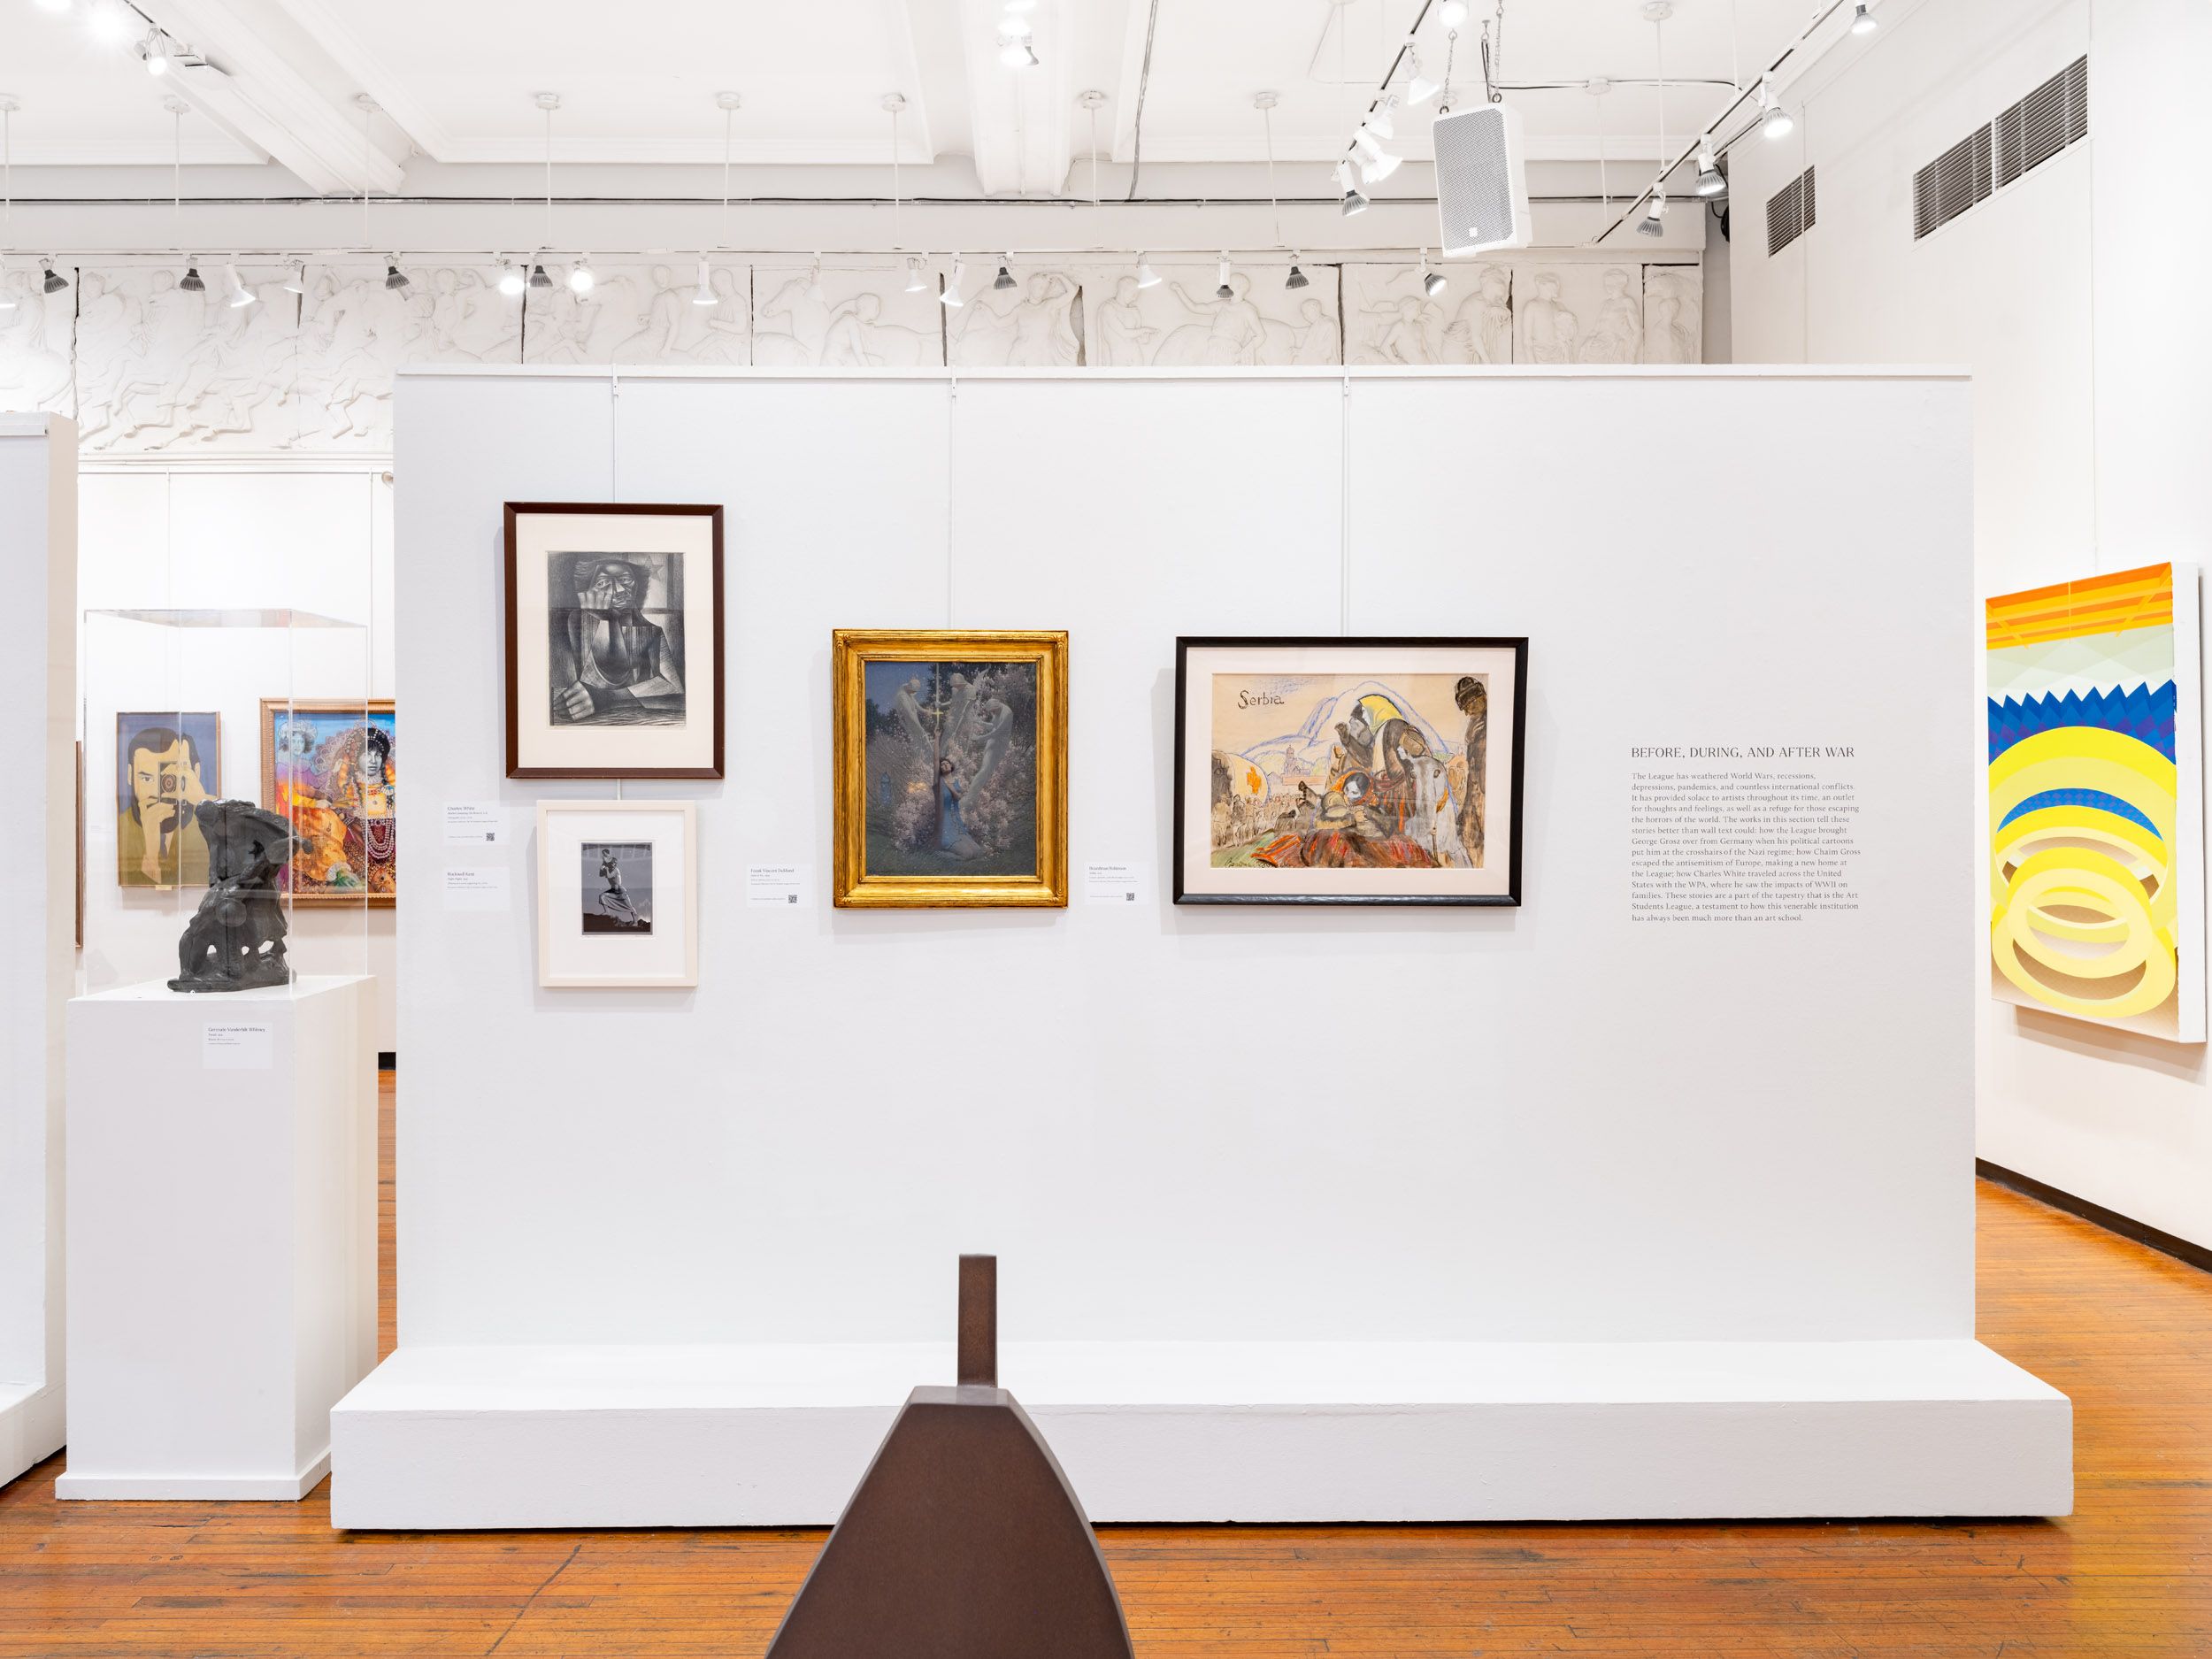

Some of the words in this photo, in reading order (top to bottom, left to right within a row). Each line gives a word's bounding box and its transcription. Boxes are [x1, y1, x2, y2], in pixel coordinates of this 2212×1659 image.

[1238, 690, 1284, 709] Serbia
[1631, 747, 1685, 759] BEFORE,
[1690, 747, 1743, 759] DURING,
[1747, 747, 1775, 758] AND
[1779, 747, 1821, 758] AFTER
[1825, 747, 1855, 758] WAR
[1647, 772, 1675, 781] League
[1631, 783, 1676, 792] depressions,
[1678, 783, 1719, 792] pandemics,
[1654, 794, 1686, 803] provided
[1747, 794, 1788, 803] throughout
[1644, 805, 1677, 814] thoughts
[1695, 805, 1725, 814] feelings,
[1769, 804, 1792, 814] refuge
[1828, 805, 1859, 814] escaping
[1790, 826, 1817, 836] League
[1818, 826, 1847, 836] brought
[1631, 837, 1658, 847] George
[1719, 837, 1755, 847] Germany
[1790, 837, 1820, 847] political
[1631, 849, 1644, 858] put
[1631, 859, 1661, 868] escaped
[1735, 859, 1763, 868] Europe,
[1765, 859, 1793, 868] making
[1775, 881, 1803, 890] impacts
[1734, 892, 1750, 901] part
[1775, 892, 1806, 901] tapestry
[1665, 902, 1694, 912] League,
[1646, 914, 1670, 923] always
